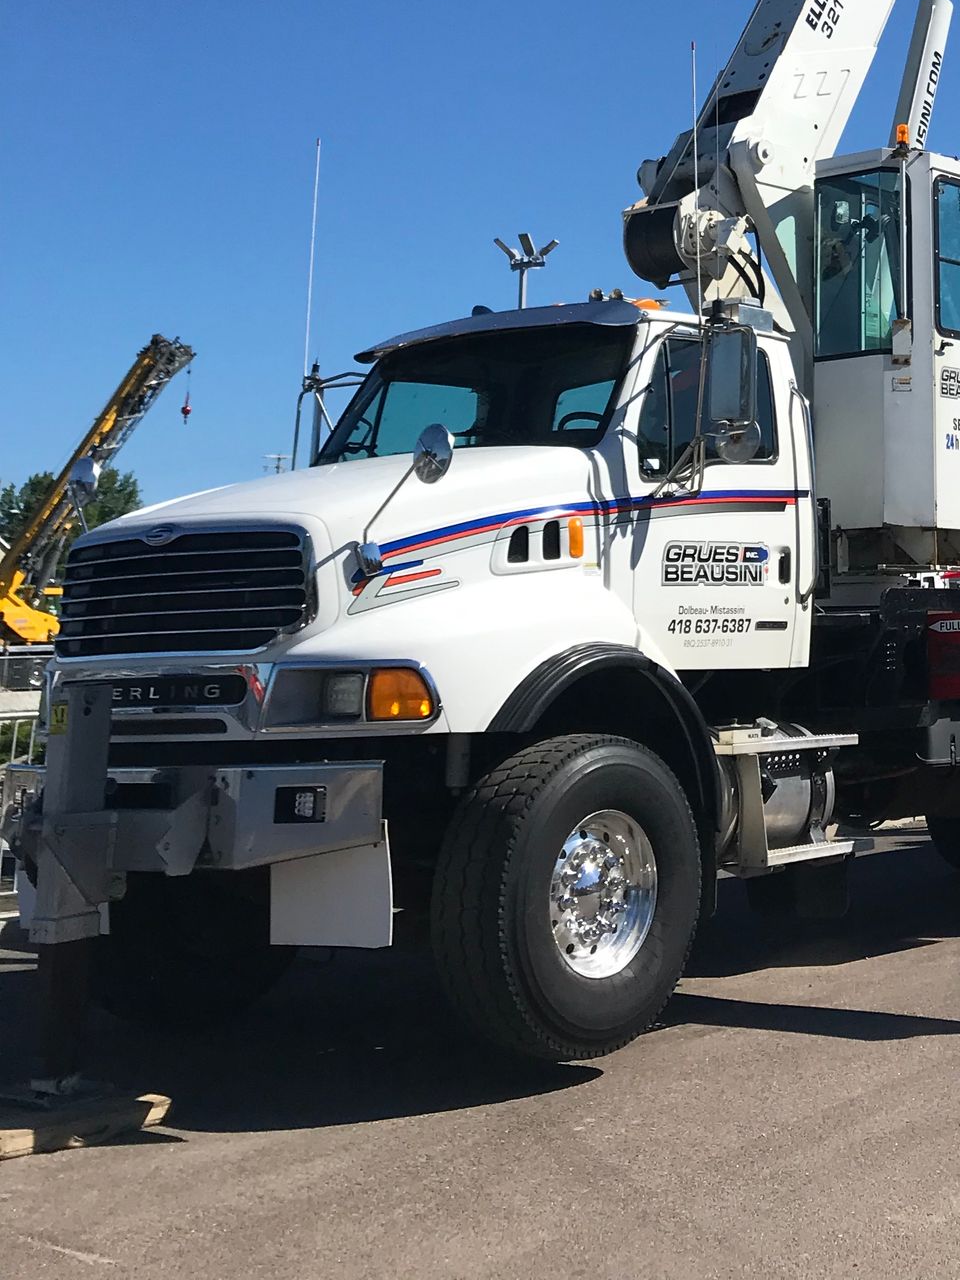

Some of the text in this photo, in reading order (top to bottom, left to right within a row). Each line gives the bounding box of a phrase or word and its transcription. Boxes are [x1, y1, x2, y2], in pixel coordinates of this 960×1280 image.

[665, 545, 740, 563] GRUES
[664, 564, 762, 582] BEAUSINI
[668, 619, 752, 634] 418 637-6387
[112, 684, 221, 700] ERLING
